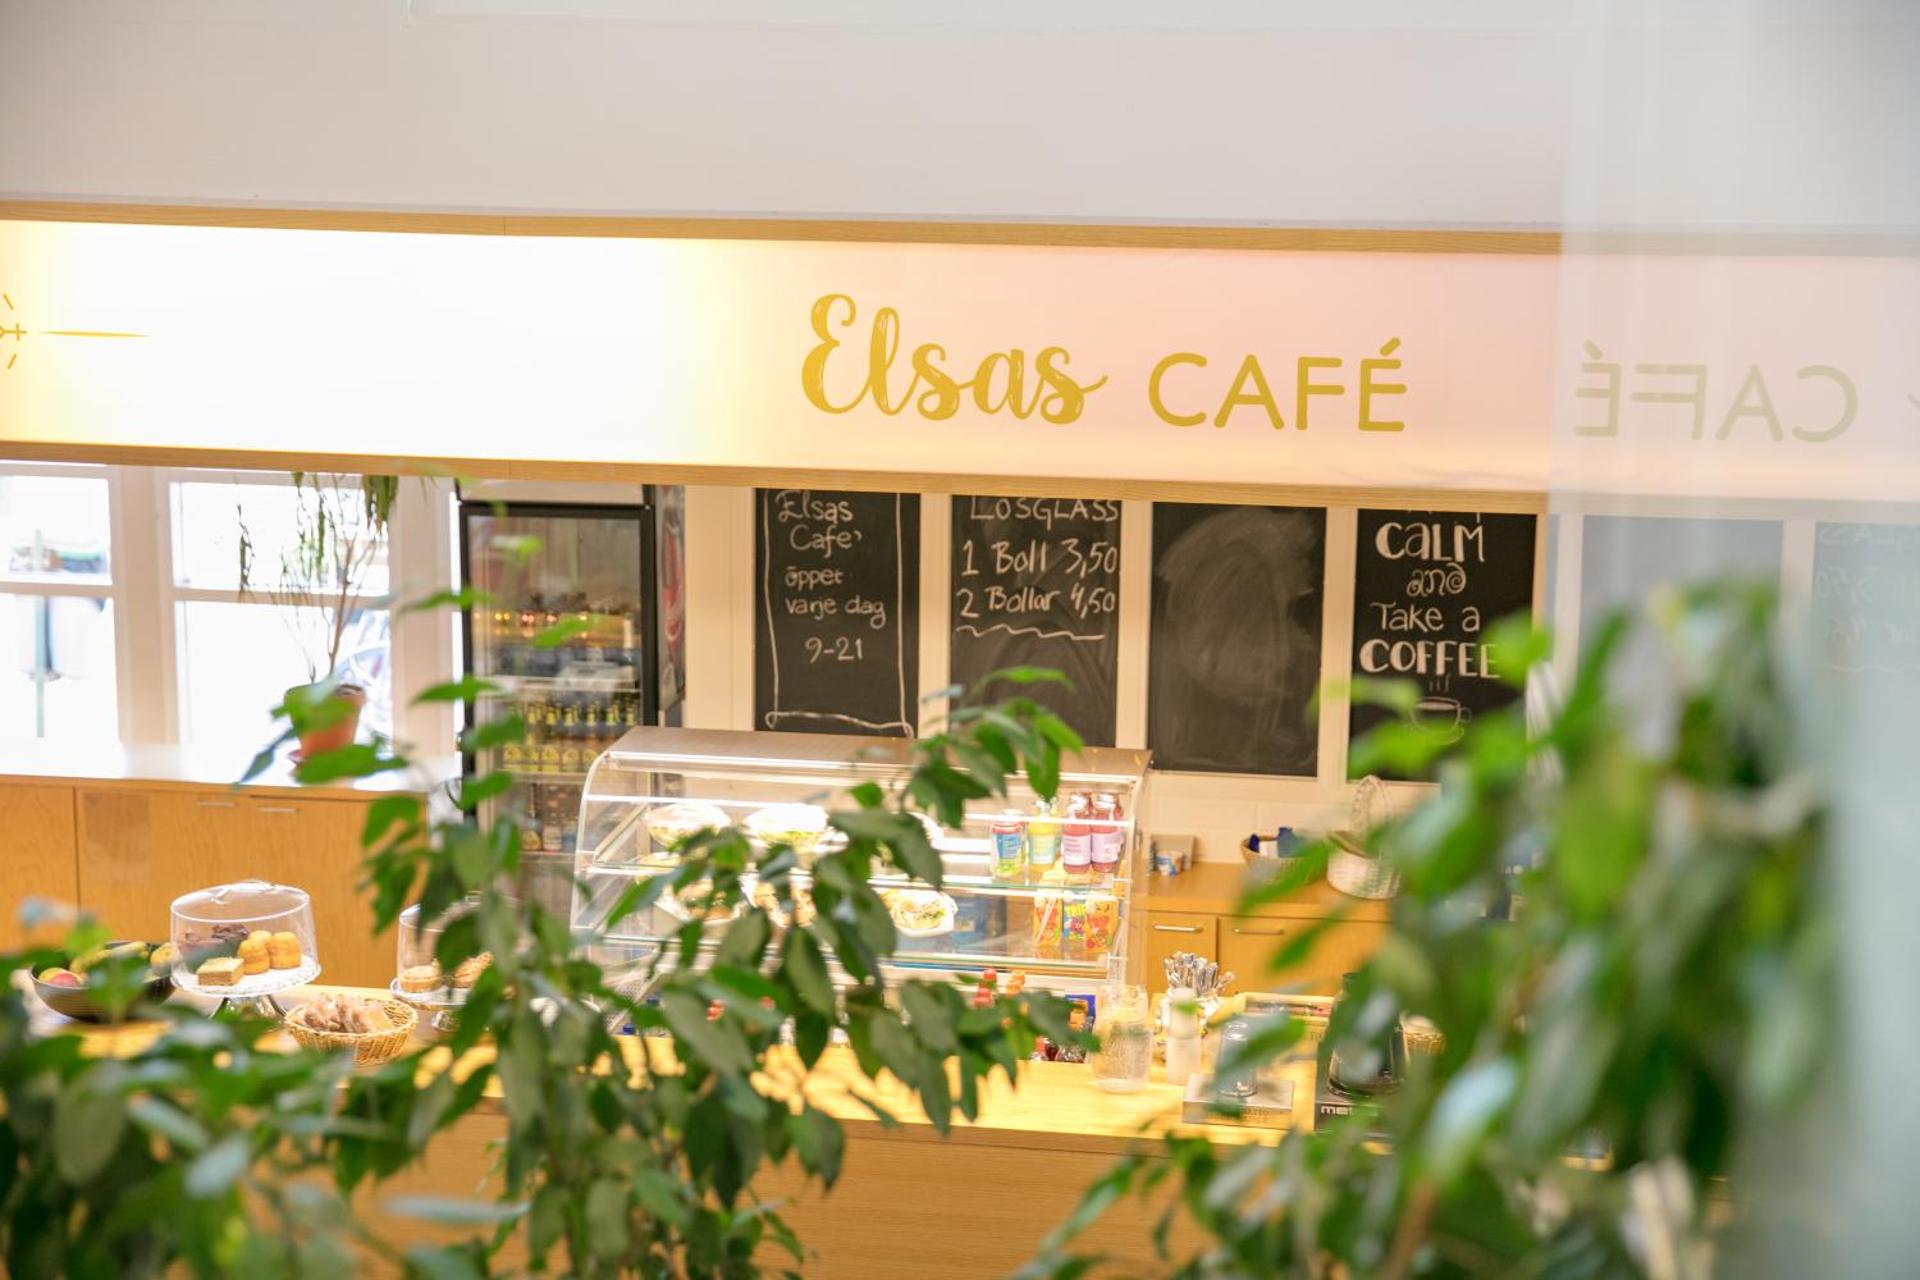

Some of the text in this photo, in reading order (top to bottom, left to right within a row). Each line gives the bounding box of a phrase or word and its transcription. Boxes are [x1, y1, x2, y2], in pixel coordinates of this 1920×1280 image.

[801, 293, 1406, 432] Elsas CAFÉ
[774, 490, 853, 524] Elsas
[961, 538, 1118, 579] 1 Boll 3,50
[1406, 562, 1466, 597] and
[844, 594, 886, 629] dag
[956, 582, 1116, 619] 2 Bollar 4,50
[1369, 601, 1481, 633] Take a
[805, 636, 863, 664] 9-21
[1359, 638, 1501, 679] COFFEE
